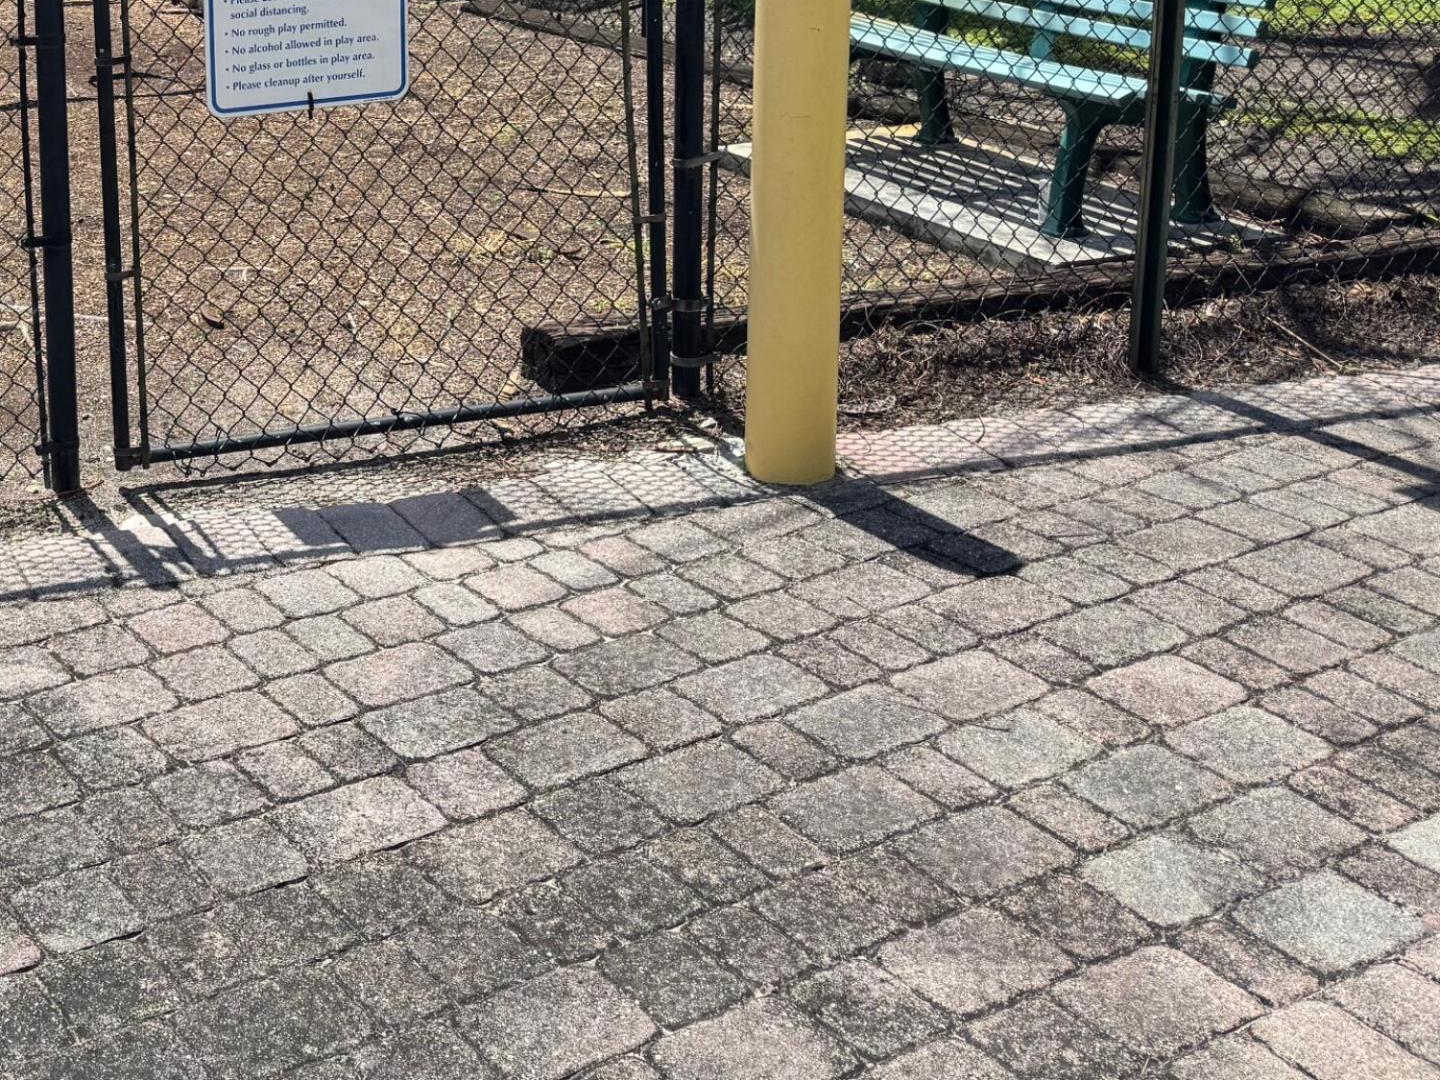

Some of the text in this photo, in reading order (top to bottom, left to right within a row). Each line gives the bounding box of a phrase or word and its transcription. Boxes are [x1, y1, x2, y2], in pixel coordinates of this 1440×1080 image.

[230, 4, 309, 20] social distancing.
[232, 18, 347, 37] No rough play permitted.
[232, 33, 379, 55] No alcohol allowed in play area.
[232, 51, 375, 73] No glass or bottles in play area.
[233, 68, 365, 90] Please cleanup after yourself.
